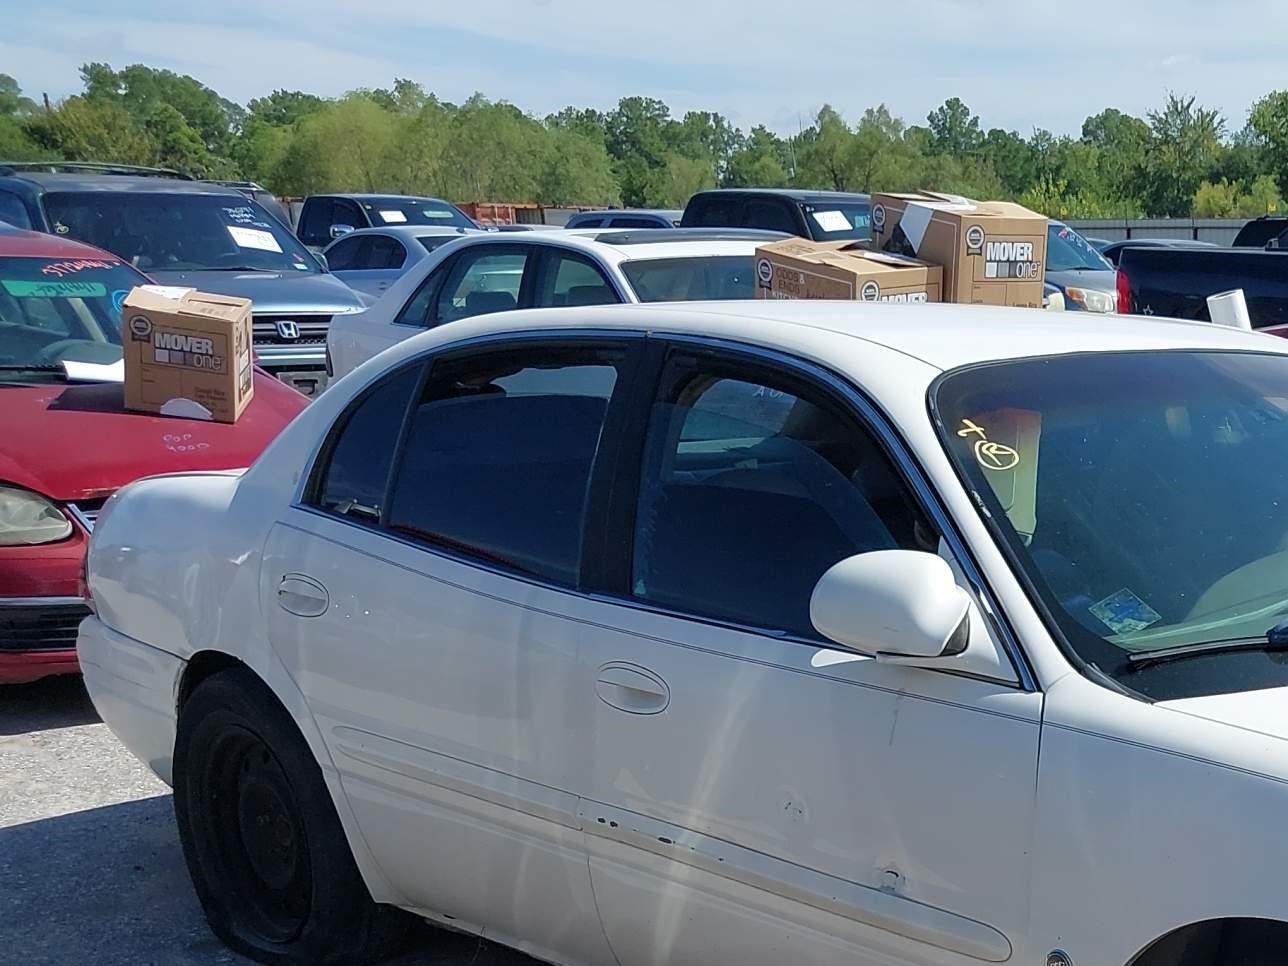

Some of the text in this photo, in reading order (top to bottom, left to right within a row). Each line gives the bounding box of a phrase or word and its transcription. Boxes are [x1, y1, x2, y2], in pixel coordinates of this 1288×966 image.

[986, 241, 1034, 261] MOVER
[1016, 262, 1038, 278] one
[154, 332, 214, 355] MOVER
[193, 353, 222, 370] one
